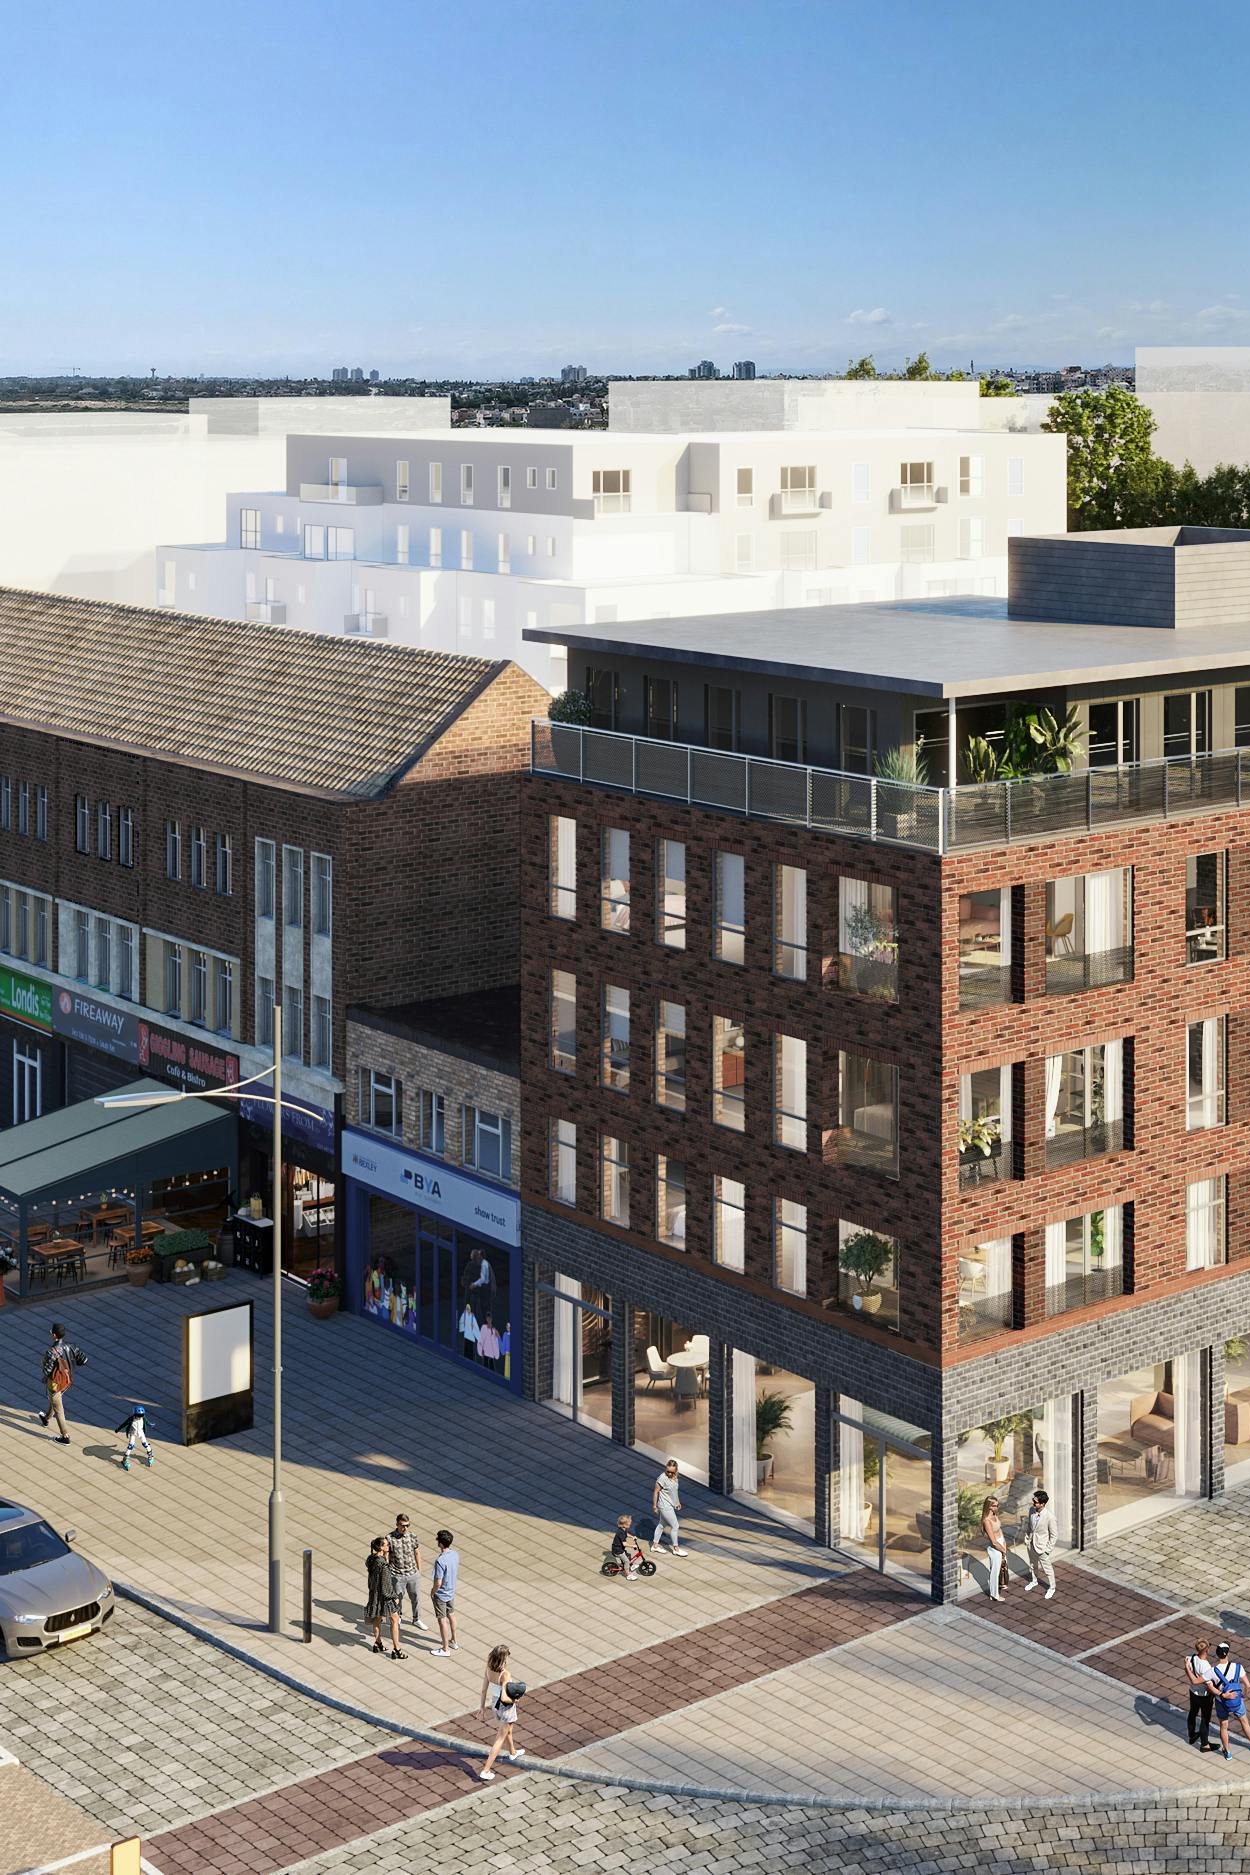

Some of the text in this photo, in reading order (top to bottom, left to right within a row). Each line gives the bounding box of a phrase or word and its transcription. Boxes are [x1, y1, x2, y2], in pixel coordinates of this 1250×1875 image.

[11, 976, 39, 1017] Londis
[74, 999, 125, 1035] FIREAWAY
[181, 1070, 187, 1080] &
[187, 1072, 206, 1087] Bistro
[189, 1047, 225, 1081] SAUSAGE
[414, 1173, 442, 1199] BYA
[474, 1205, 506, 1227] show trust
